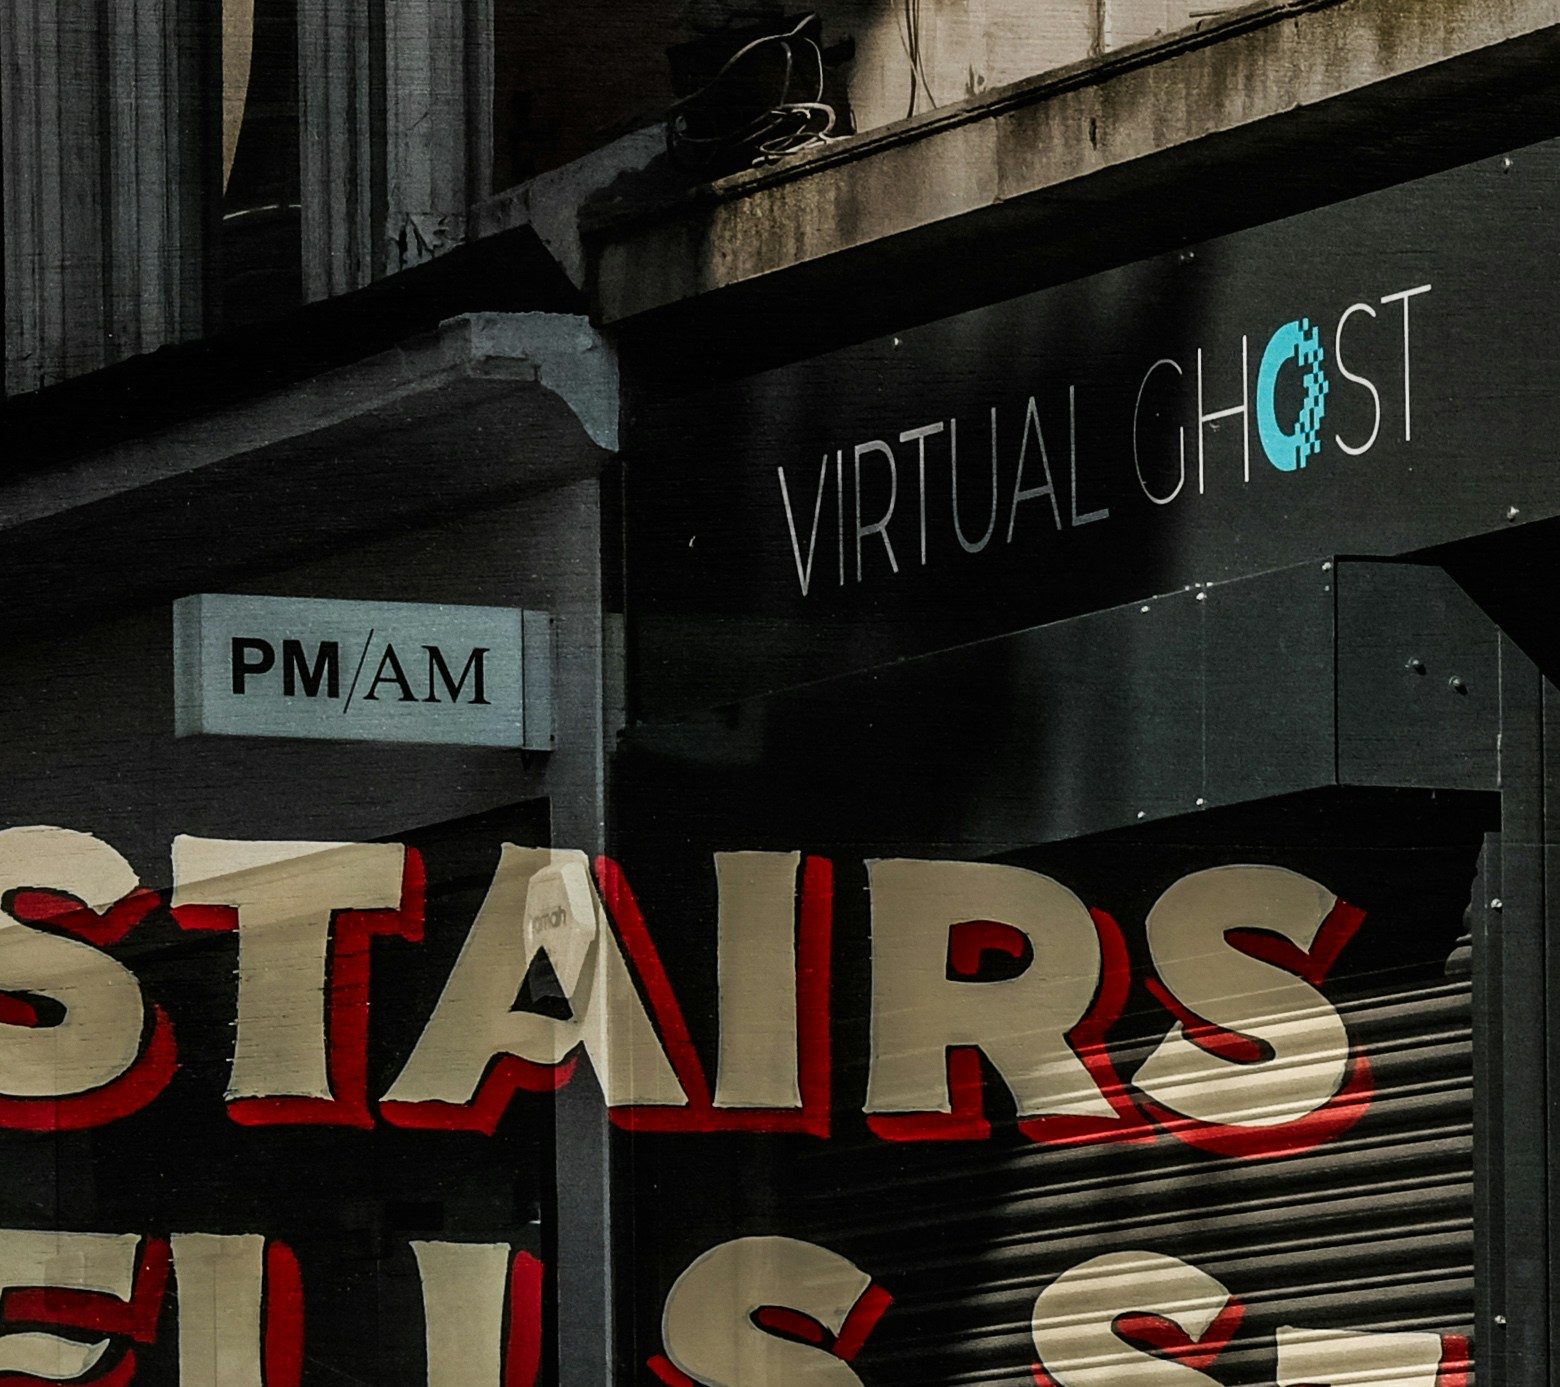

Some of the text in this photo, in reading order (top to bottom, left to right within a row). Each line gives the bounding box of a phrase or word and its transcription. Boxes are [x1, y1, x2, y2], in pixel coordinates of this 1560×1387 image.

[778, 283, 1432, 596] VIRTUAL GHOST
[230, 628, 491, 714] PM/AM
[0, 826, 1375, 1158] STAIRS
